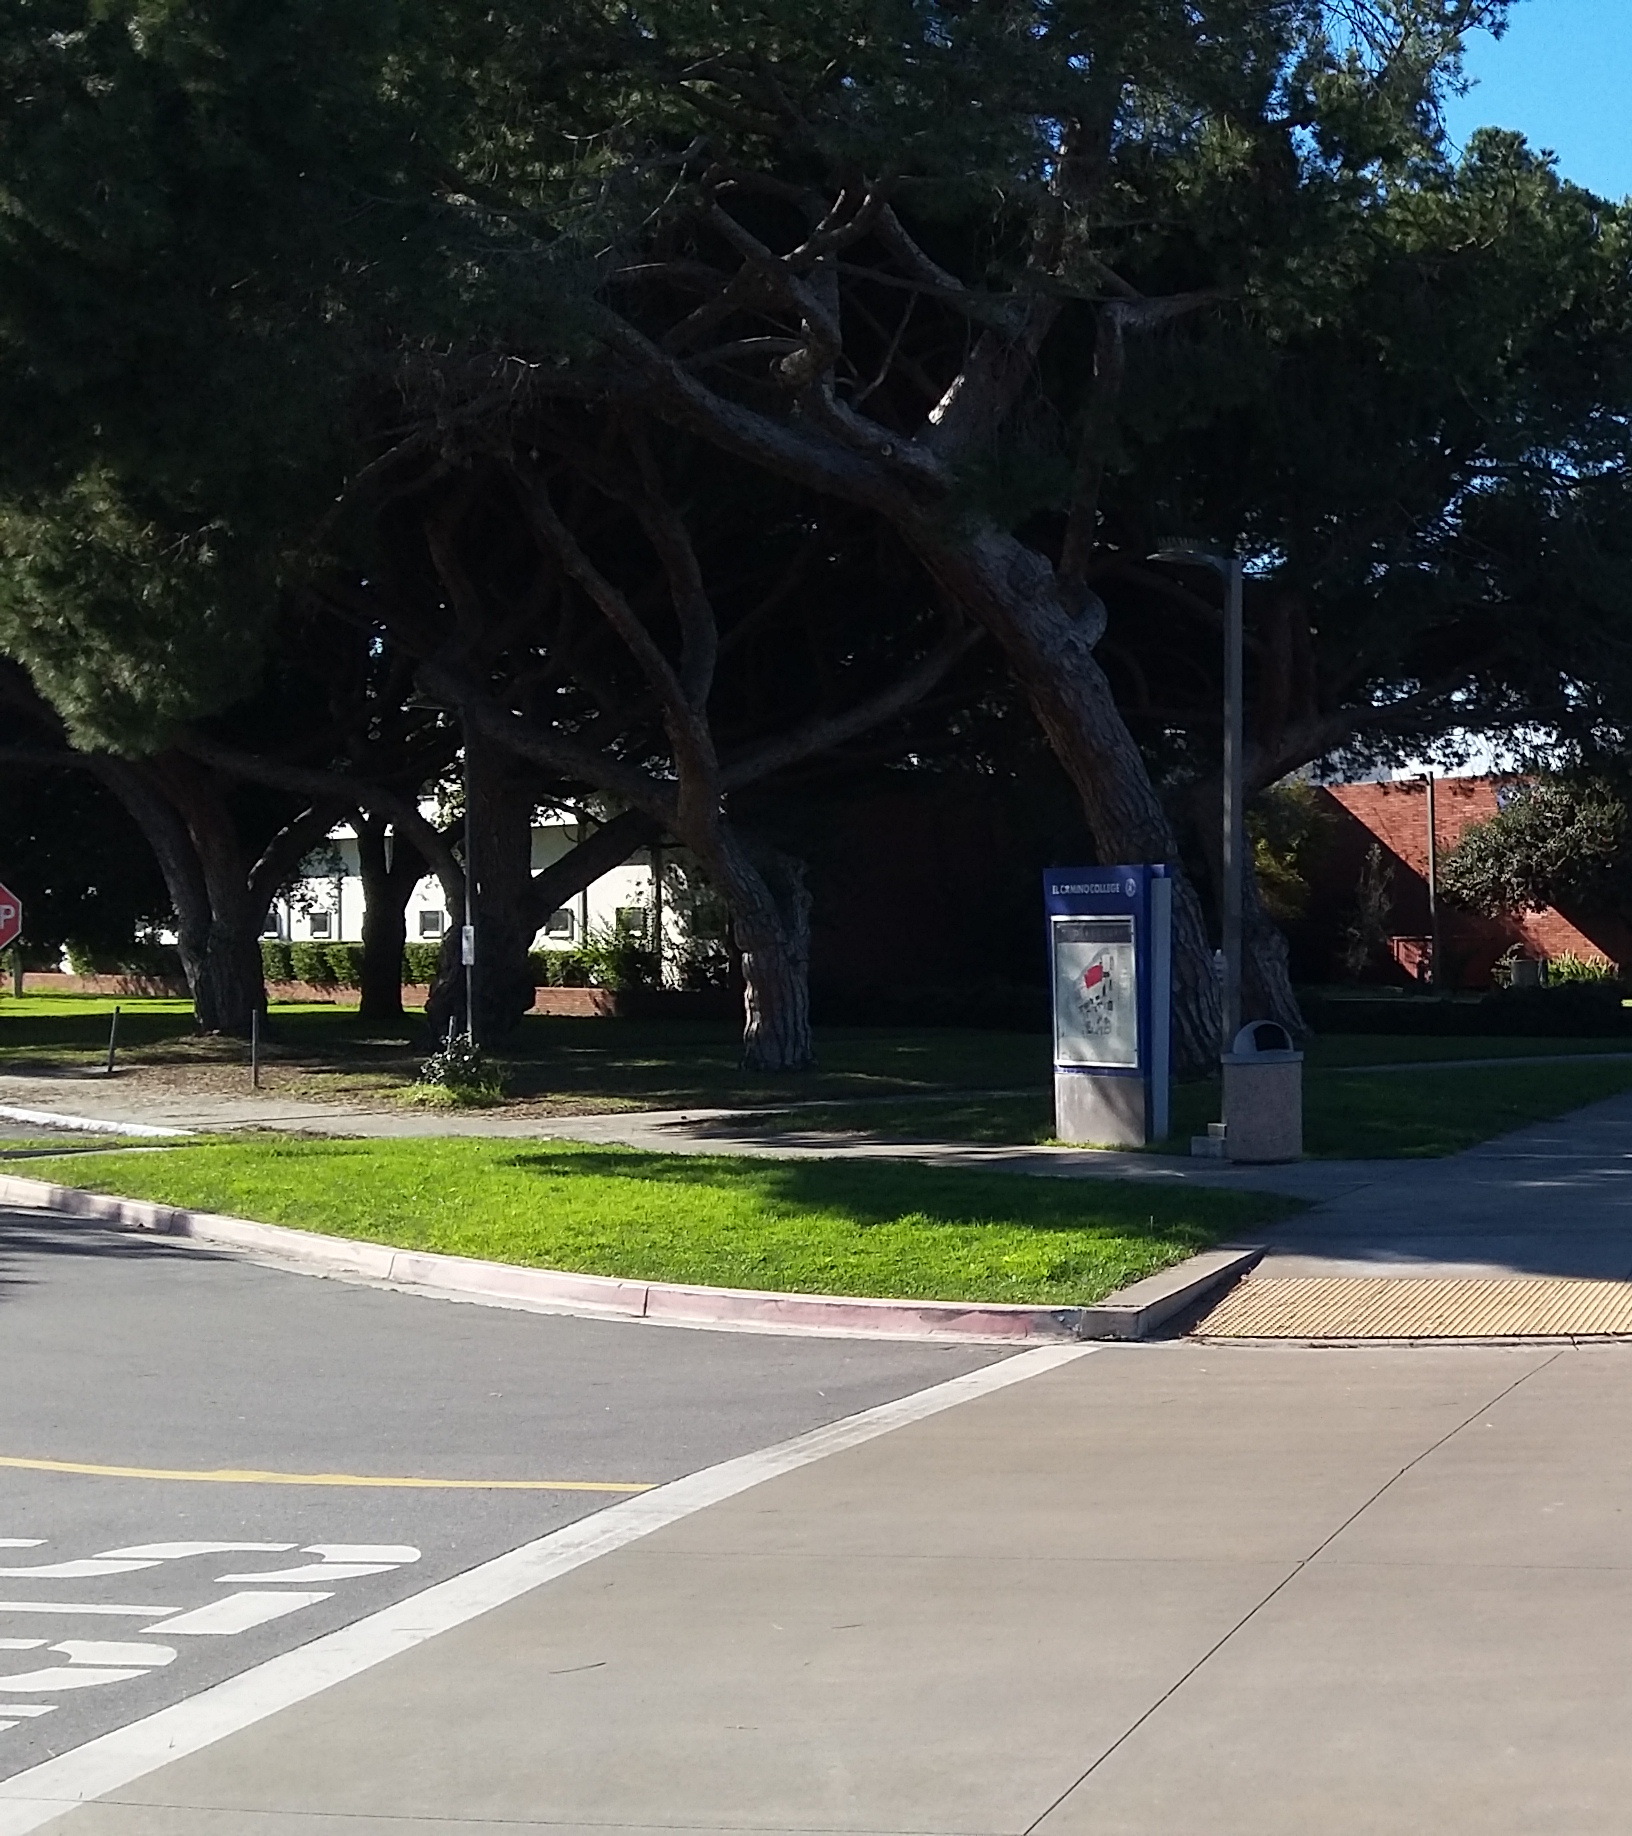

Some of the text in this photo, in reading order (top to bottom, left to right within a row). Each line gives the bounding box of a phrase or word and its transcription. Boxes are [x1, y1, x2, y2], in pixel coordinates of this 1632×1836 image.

[1052, 883, 1120, 895] EL CAMINO COLLEGE
